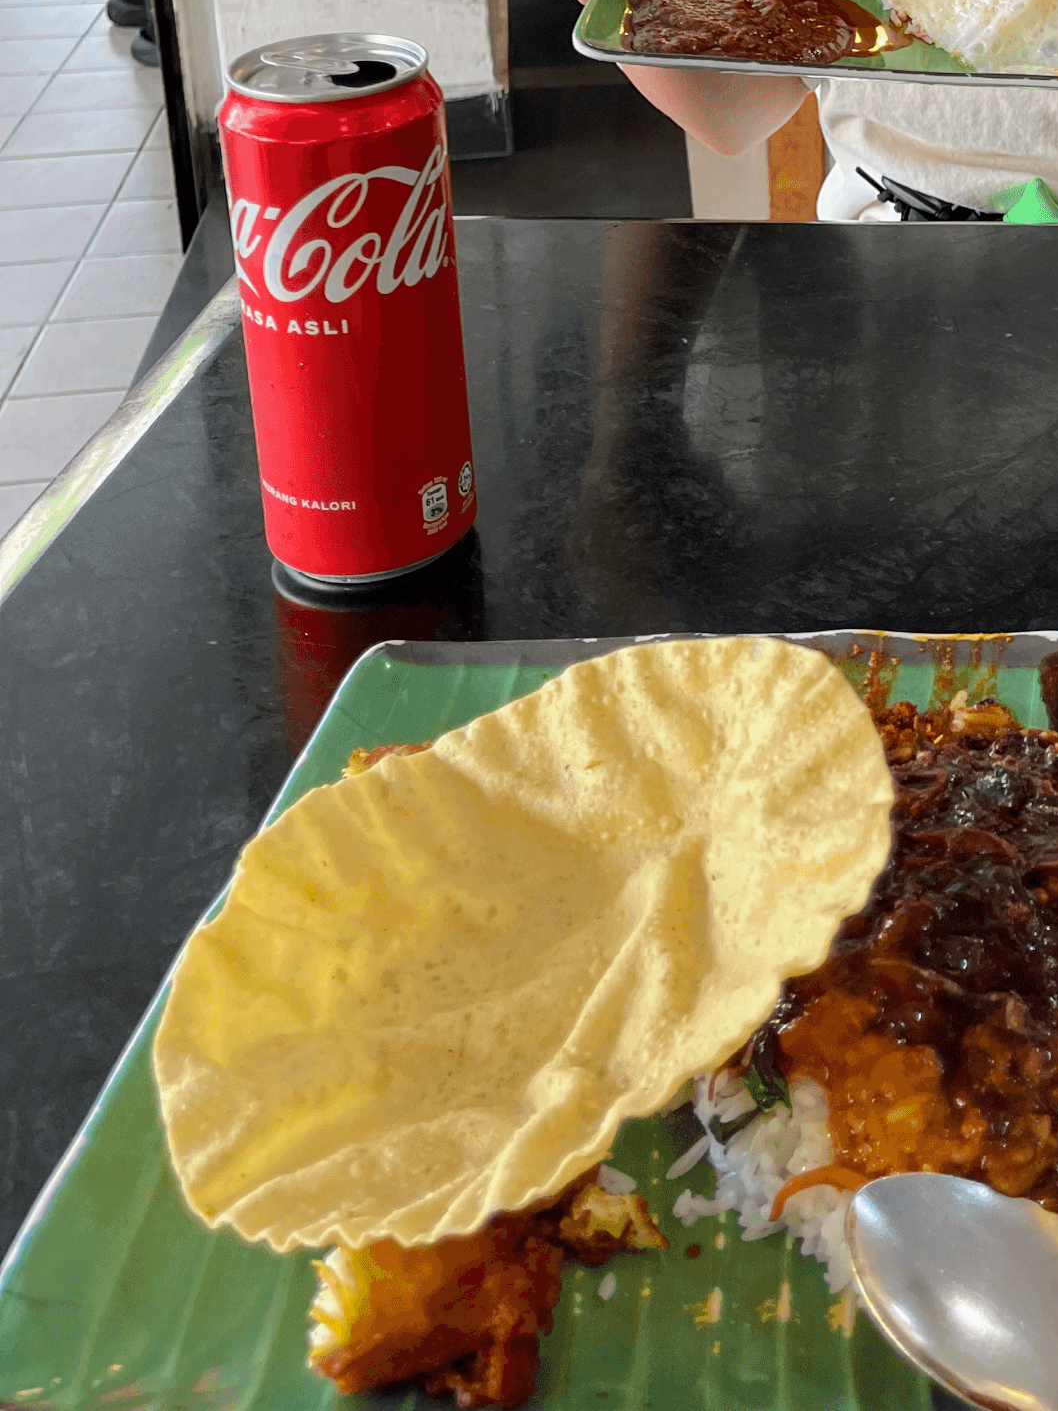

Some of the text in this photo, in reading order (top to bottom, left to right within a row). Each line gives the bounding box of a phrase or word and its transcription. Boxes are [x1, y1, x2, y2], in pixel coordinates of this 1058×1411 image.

[226, 144, 448, 303] a-Cola
[287, 319, 349, 335] ASLI
[301, 499, 357, 511] KALORI
